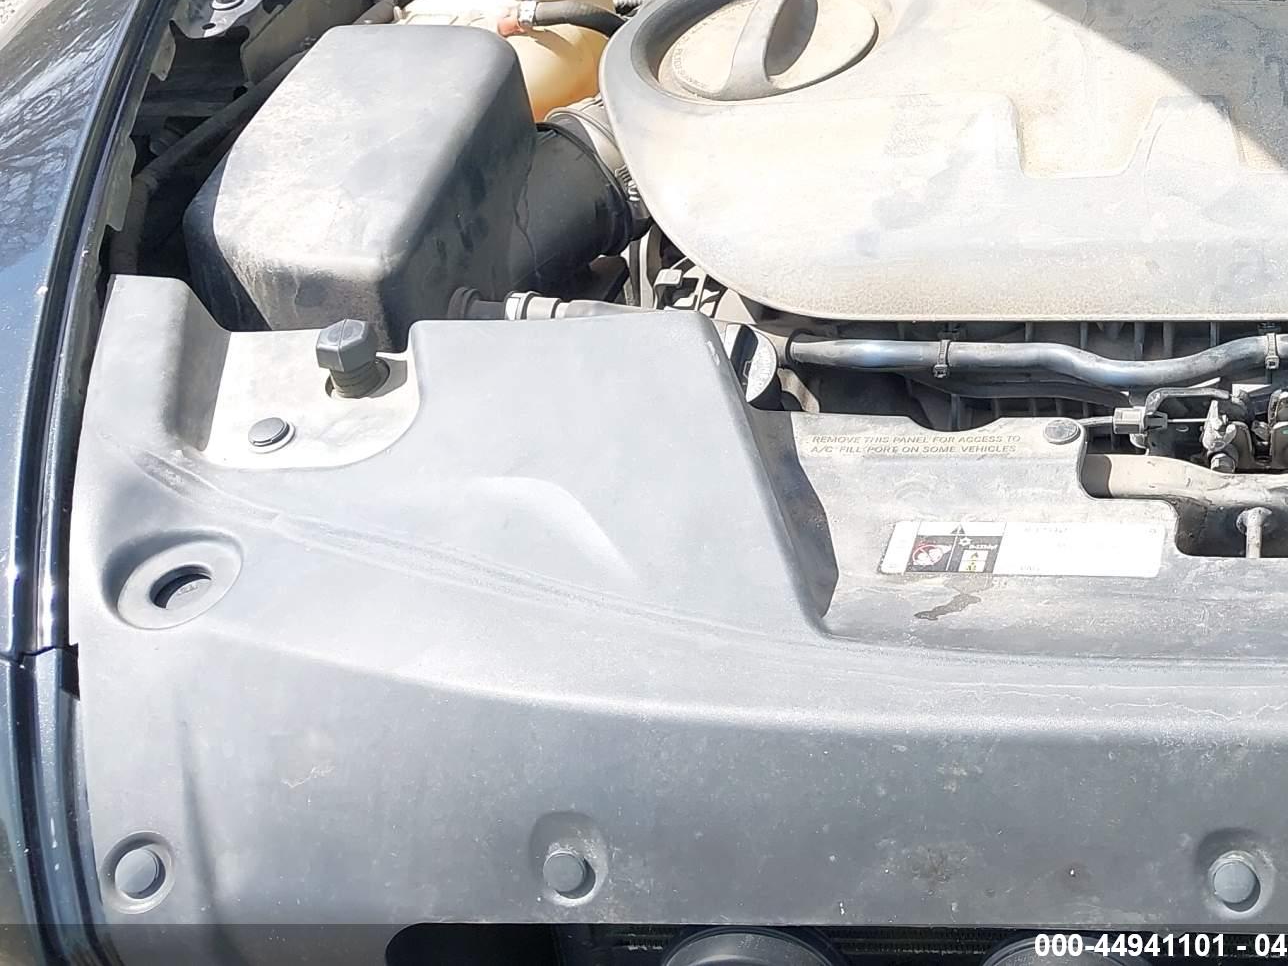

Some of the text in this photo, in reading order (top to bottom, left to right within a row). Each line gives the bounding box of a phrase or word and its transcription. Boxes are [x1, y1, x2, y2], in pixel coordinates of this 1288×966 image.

[812, 435, 1021, 444] REMOVE THIS PANEL FOR ACCESS TO
[810, 445, 834, 453] A/C
[839, 445, 862, 453] FILL
[901, 445, 919, 453] ON
[921, 445, 957, 453] SOME
[961, 445, 1017, 453] VEHICLES
